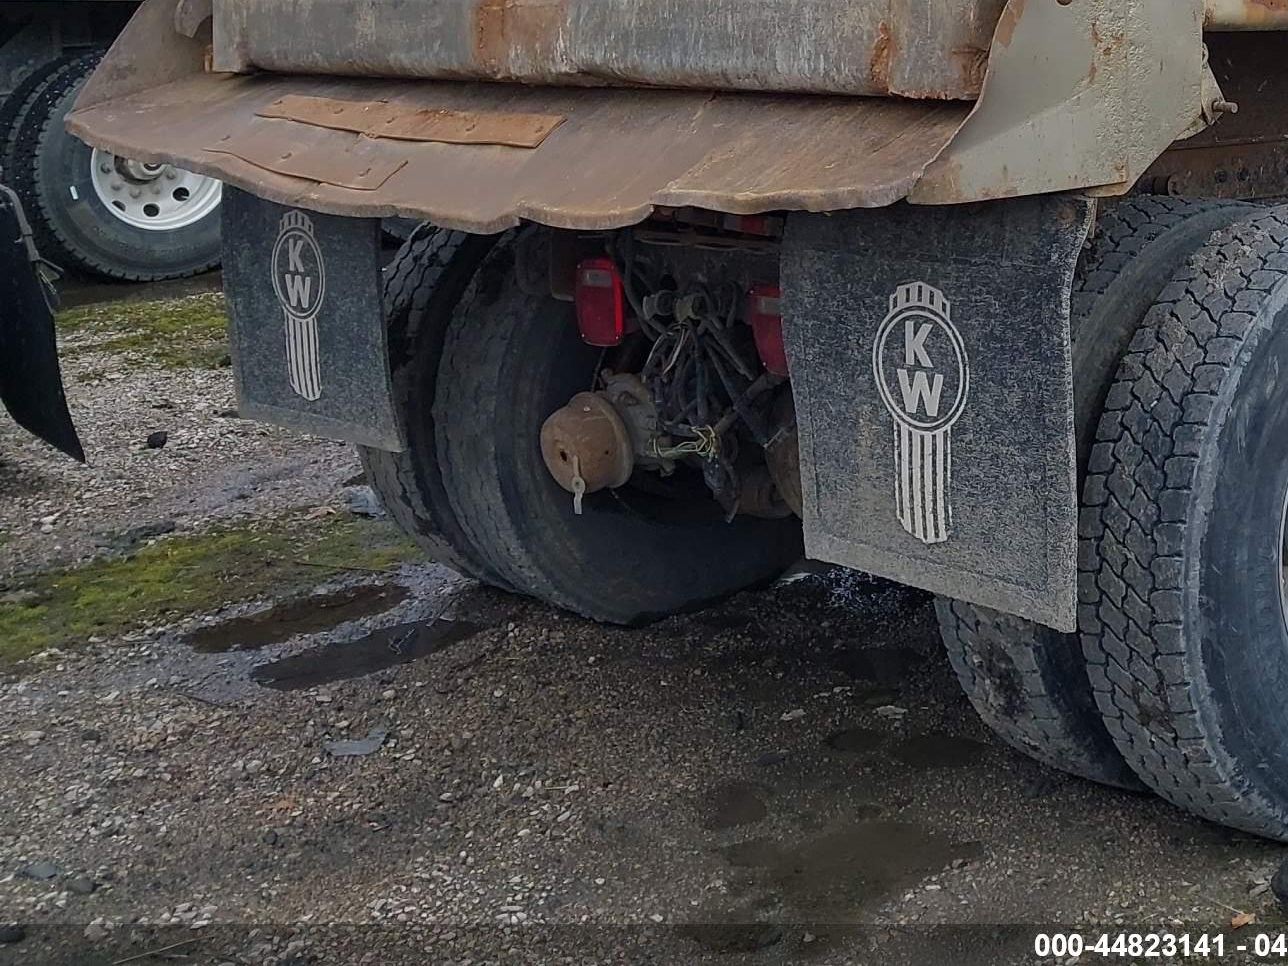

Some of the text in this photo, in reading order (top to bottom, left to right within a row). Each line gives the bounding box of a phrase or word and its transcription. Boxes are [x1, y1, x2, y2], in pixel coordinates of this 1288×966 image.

[288, 238, 305, 273] K
[284, 274, 311, 309] W
[904, 321, 934, 368] K
[897, 368, 945, 417] W
